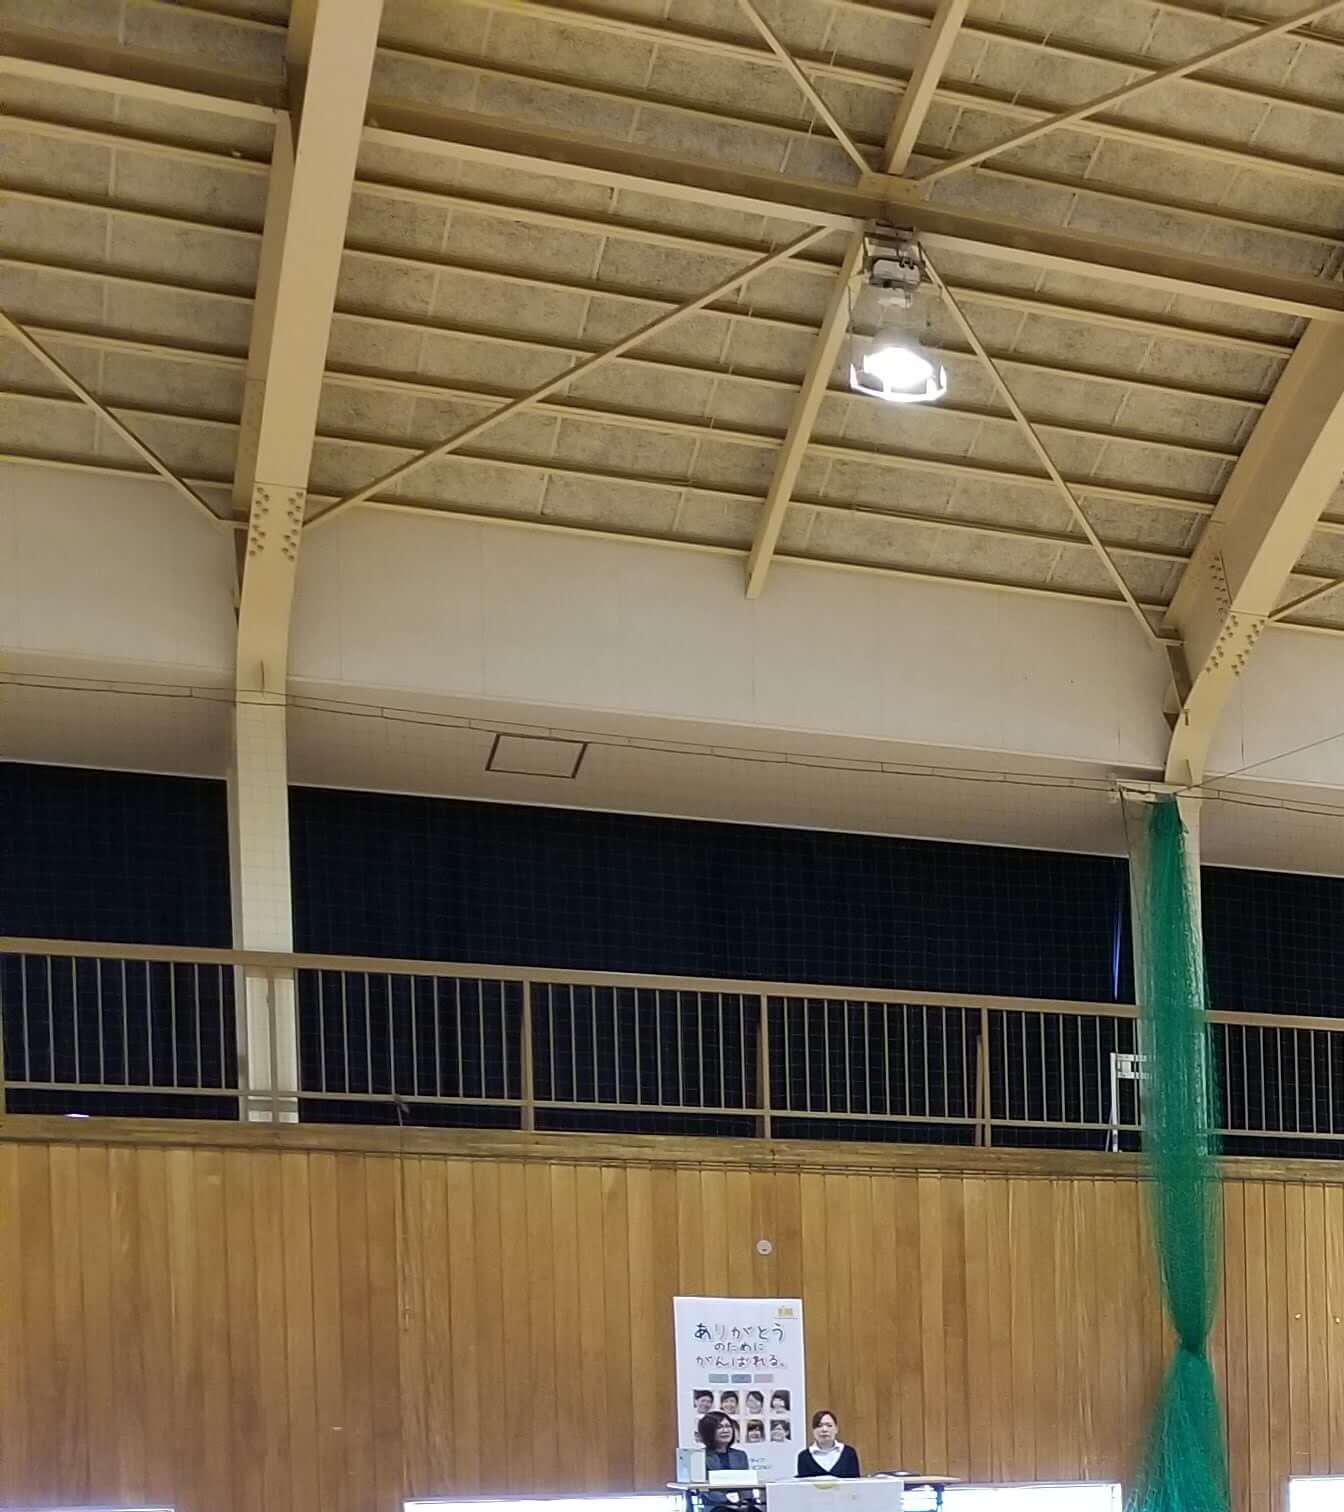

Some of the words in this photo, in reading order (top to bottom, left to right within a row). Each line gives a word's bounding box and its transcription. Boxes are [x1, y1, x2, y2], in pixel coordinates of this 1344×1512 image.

[694, 1322, 784, 1341] ありがとう
[714, 1341, 765, 1353] のために
